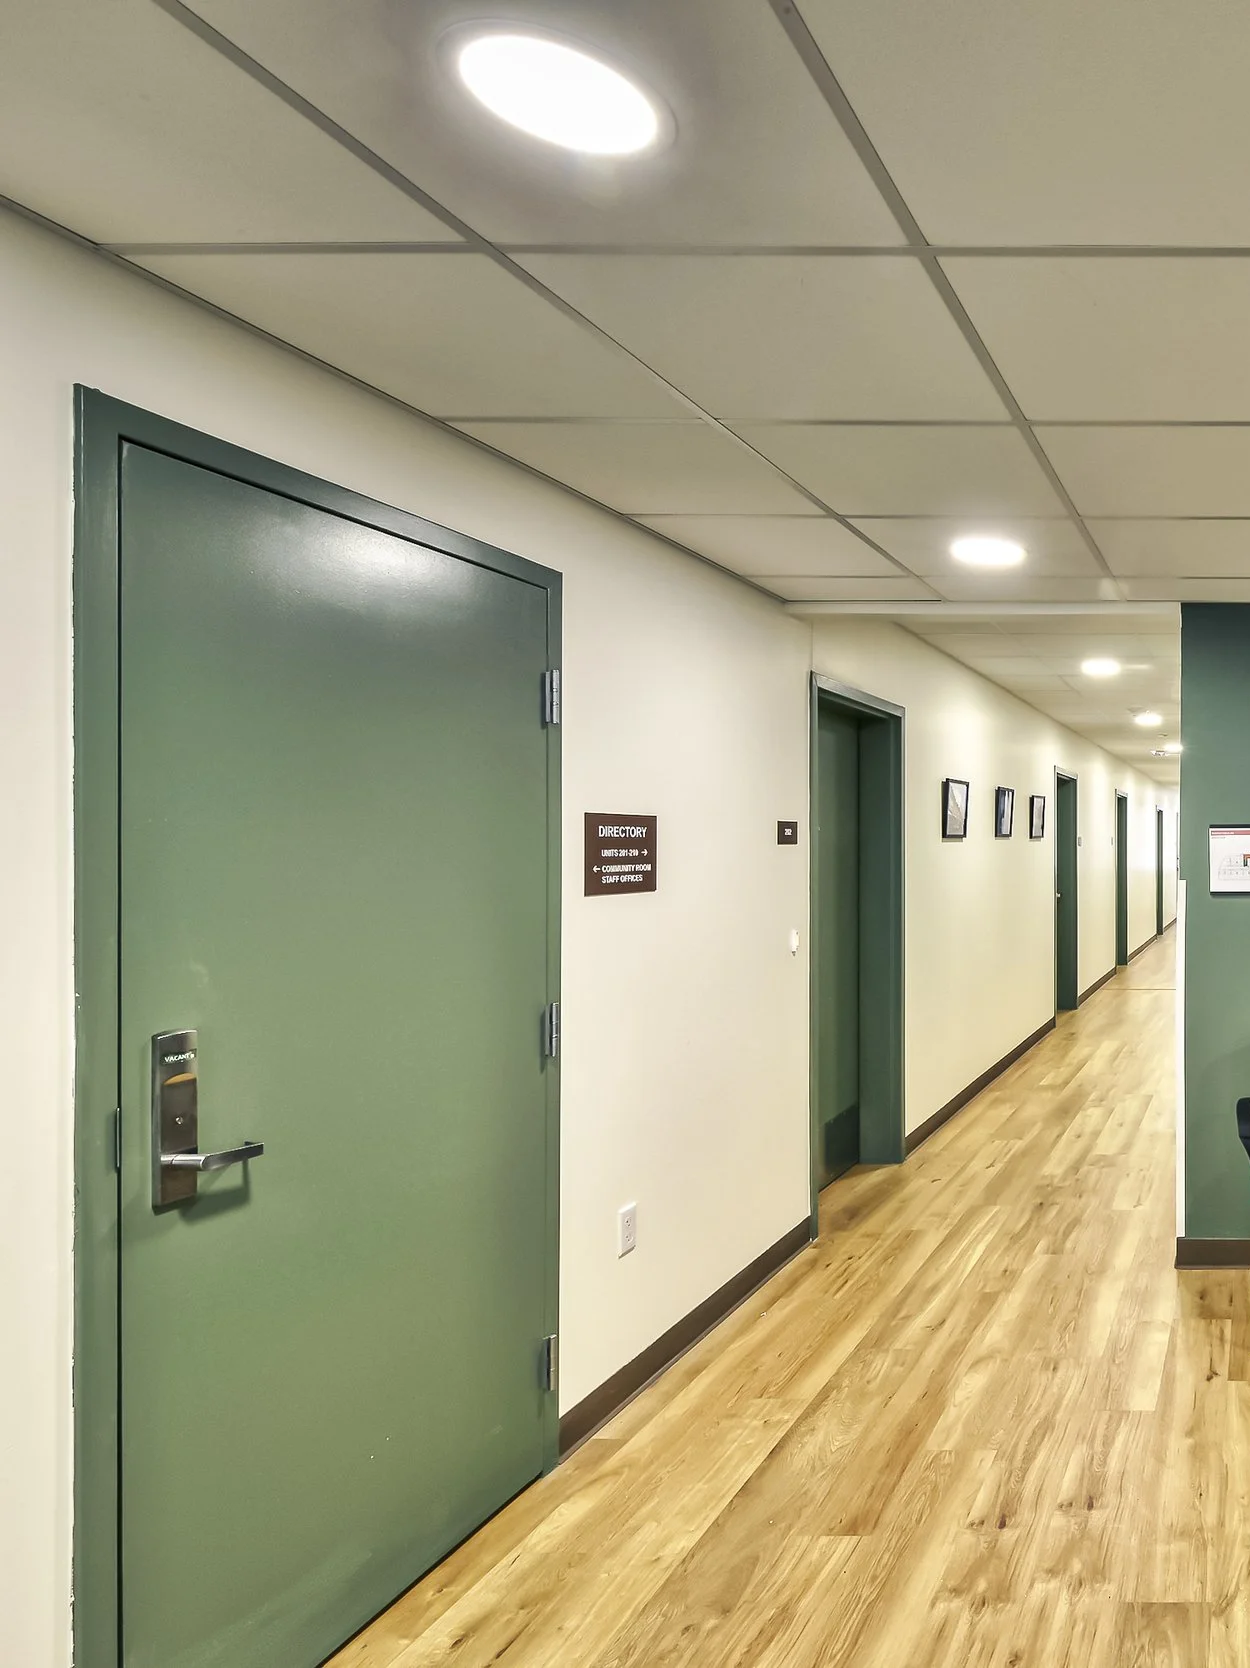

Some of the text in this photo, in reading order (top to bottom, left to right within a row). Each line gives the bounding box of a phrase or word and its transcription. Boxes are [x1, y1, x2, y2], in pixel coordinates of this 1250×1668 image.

[598, 825, 648, 838] DIRECTORY
[601, 849, 619, 857] UNITS
[601, 864, 635, 873] COMMUNITY
[601, 874, 643, 884] STAFF OFFICES
[164, 1052, 192, 1062] VACANT
